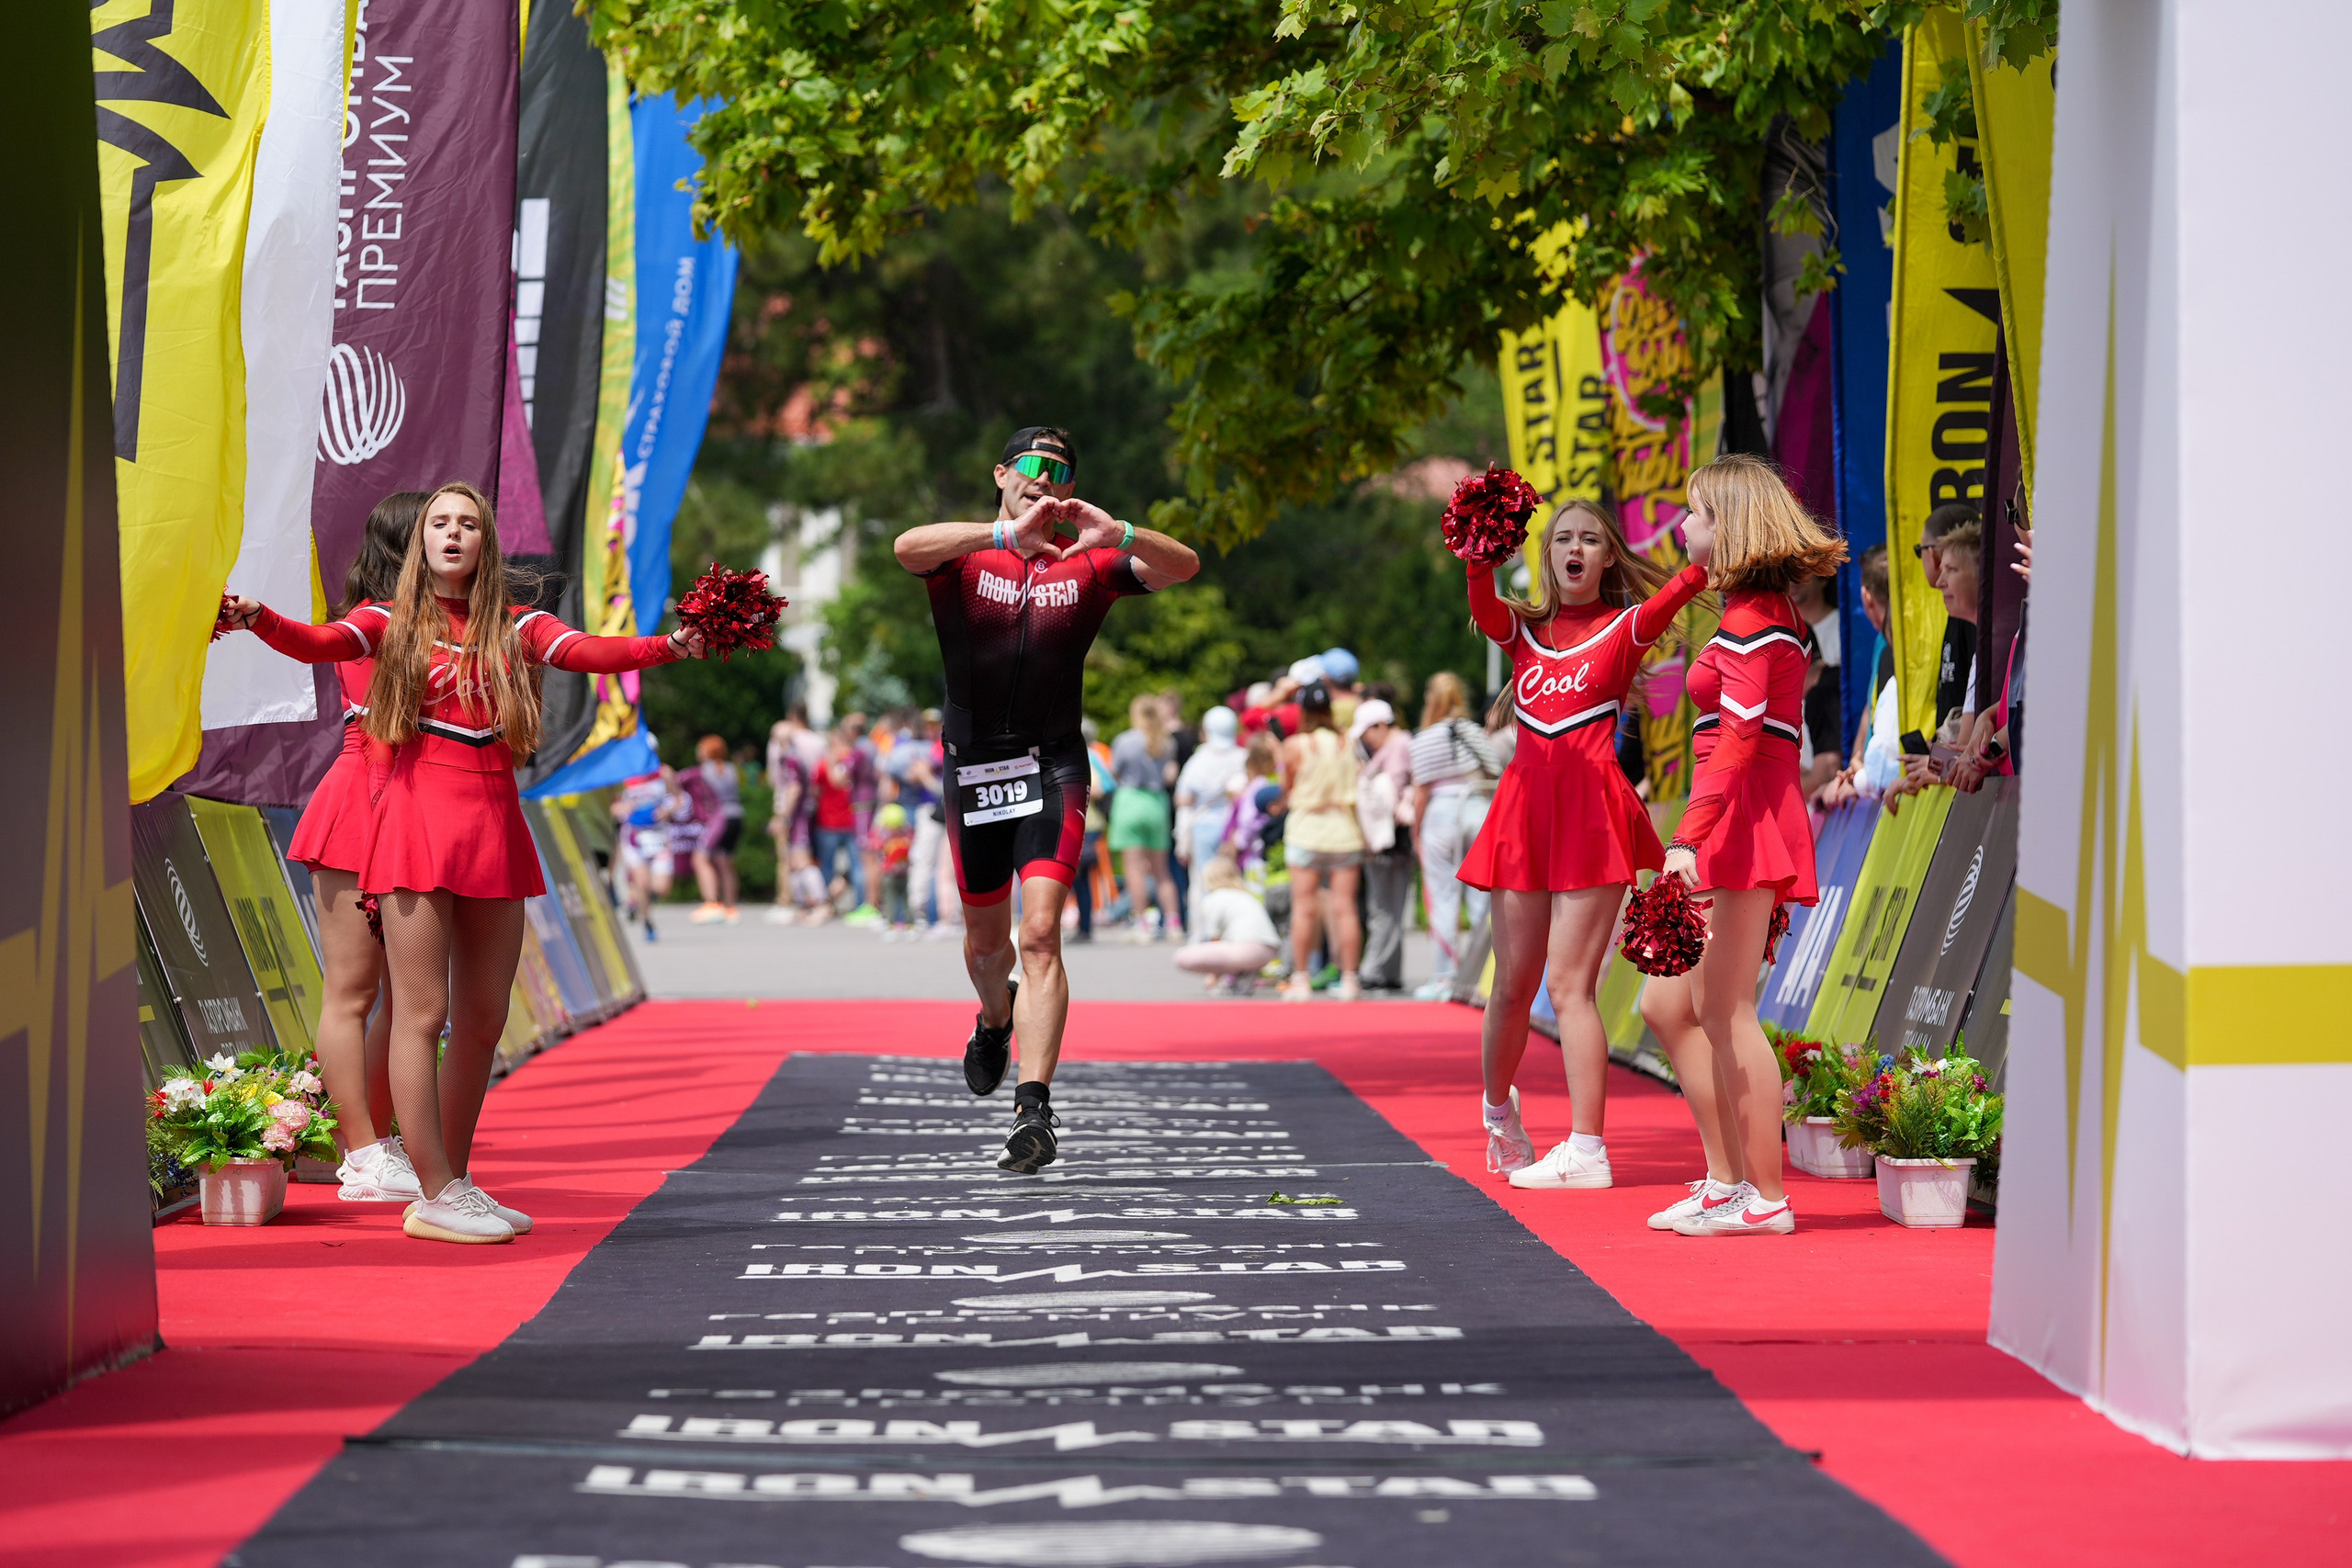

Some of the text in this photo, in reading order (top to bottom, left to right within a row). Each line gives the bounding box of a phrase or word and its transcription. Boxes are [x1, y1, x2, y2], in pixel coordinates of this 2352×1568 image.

[356, 56, 413, 310] ПРЕМИУМ
[638, 256, 695, 459] СТРАХОВОЙ ДОМ
[1517, 342, 1555, 464] STAR
[977, 569, 1018, 604] IRON
[1035, 579, 1080, 607] STAR
[1517, 662, 1589, 706] Cool
[975, 780, 1028, 808] 3019
[992, 807, 1016, 817] NIKOLAY
[775, 1208, 1358, 1220] IRON STAR
[744, 1260, 1406, 1275] IRON STAR
[697, 1325, 1463, 1346] IRON STAR
[627, 1415, 1542, 1442] IRON STAR
[585, 1465, 1597, 1497] IRON STAR
